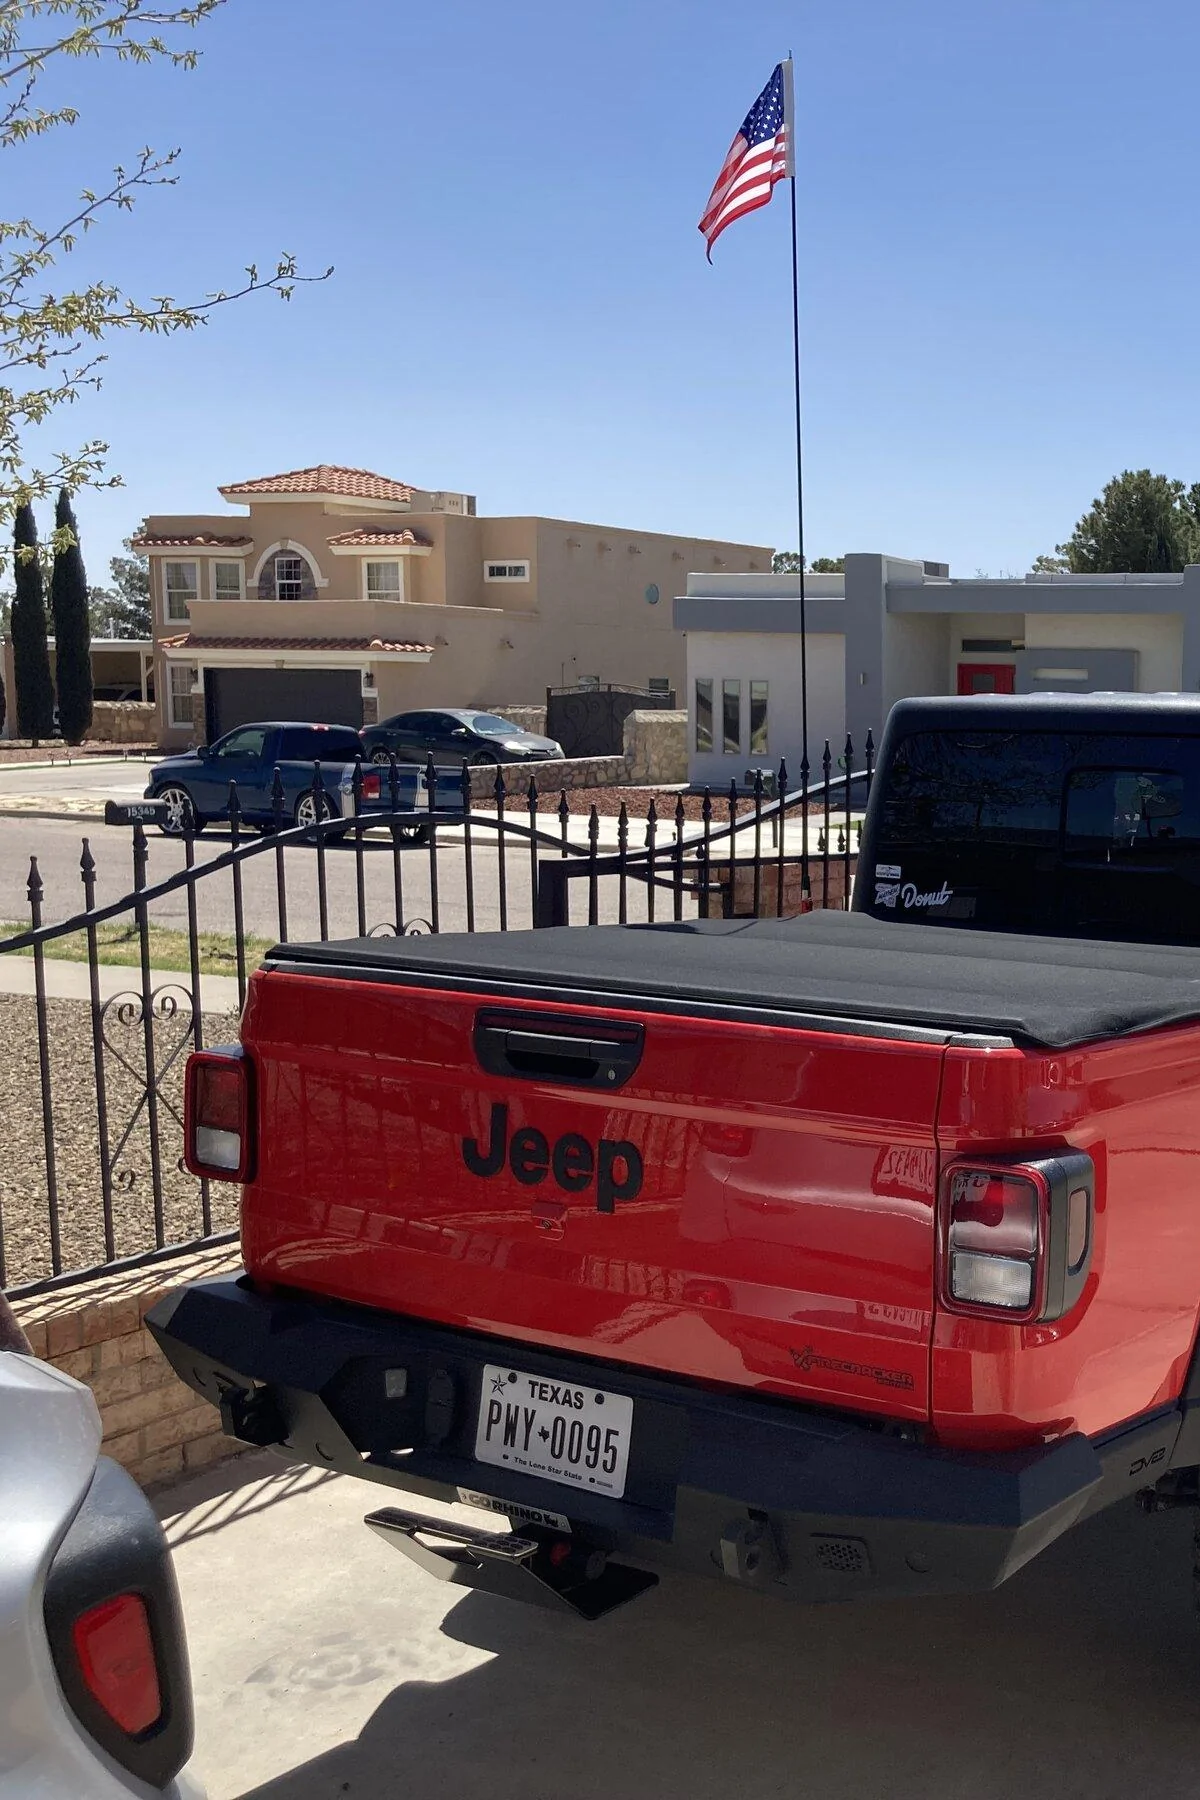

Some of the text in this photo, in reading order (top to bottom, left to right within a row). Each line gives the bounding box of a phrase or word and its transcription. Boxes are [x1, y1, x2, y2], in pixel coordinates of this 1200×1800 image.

[901, 881, 953, 908] Donut
[462, 1102, 644, 1214] Jeep
[528, 1379, 584, 1410] TEXAS
[485, 1399, 620, 1474] PWY 0095
[514, 1456, 583, 1481] The Lone Star State
[492, 1501, 543, 1522] RHINO
